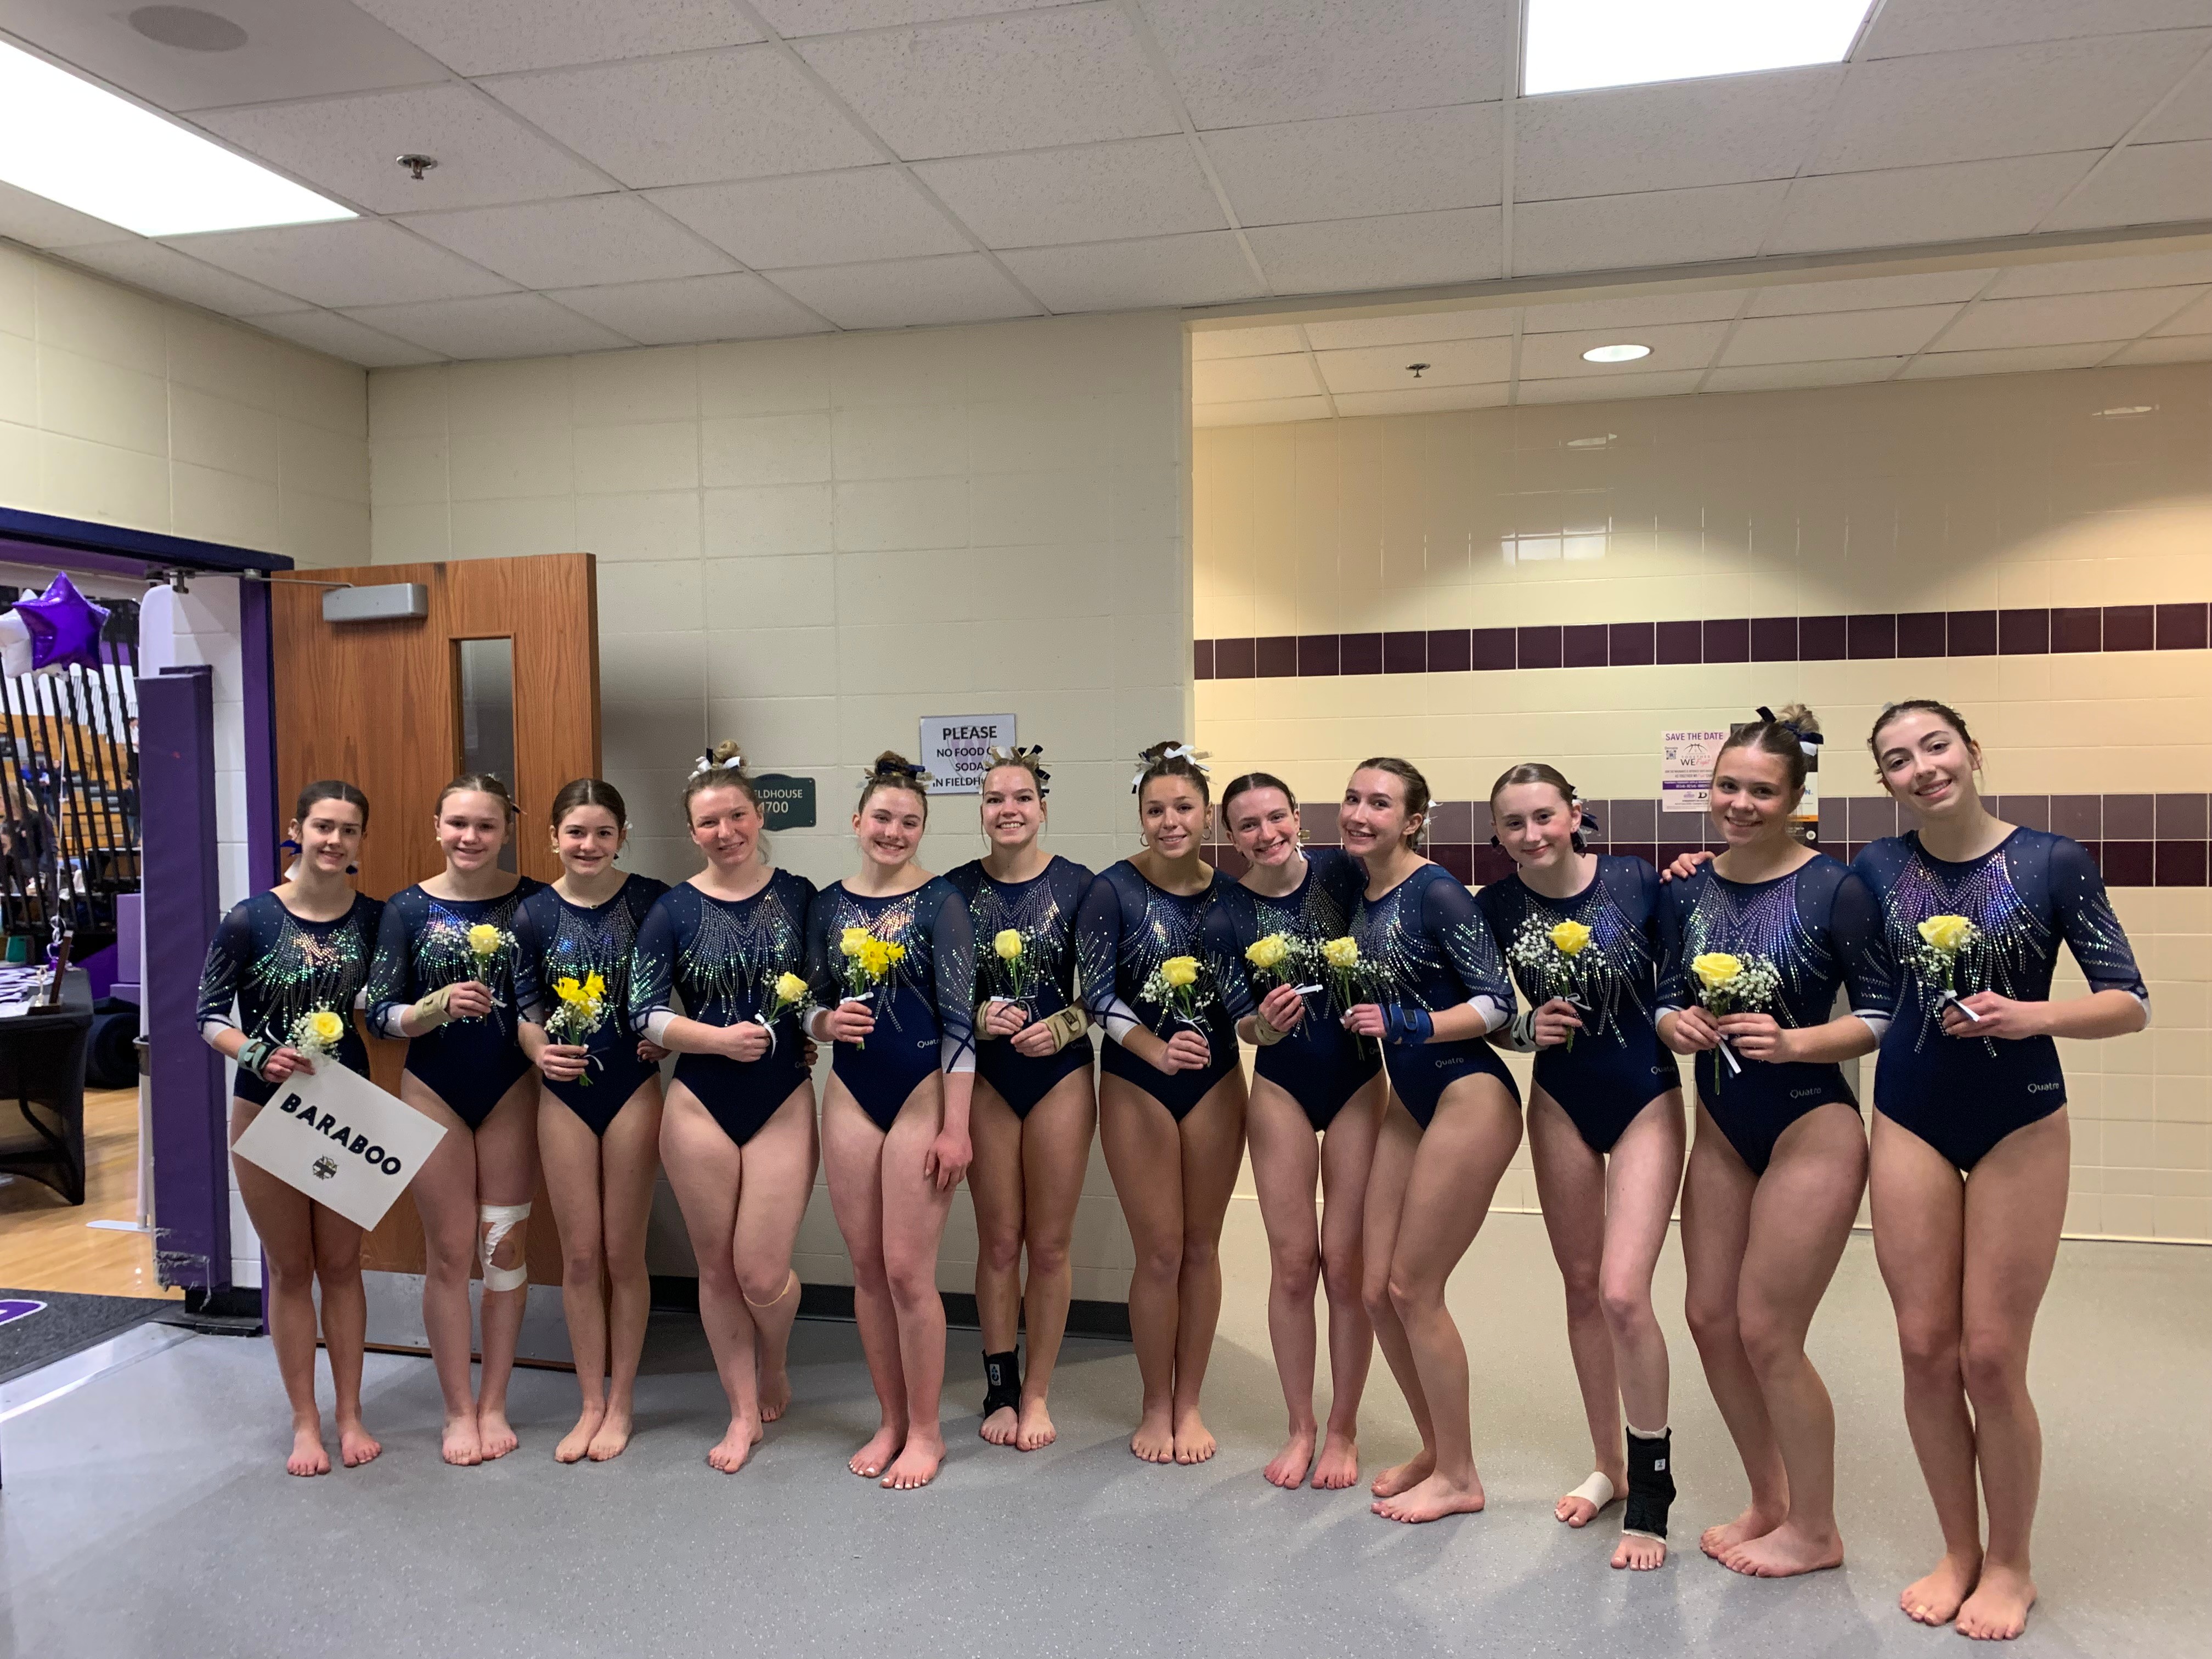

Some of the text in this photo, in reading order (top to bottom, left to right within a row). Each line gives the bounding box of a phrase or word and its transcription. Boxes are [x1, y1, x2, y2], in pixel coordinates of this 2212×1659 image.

[943, 725, 997, 741] PLEASE
[1704, 732, 1724, 740] DATE
[936, 748, 953, 758] NO
[955, 747, 985, 757] FOOD
[955, 761, 984, 771] SODA
[945, 777, 982, 787] FIELDH
[1435, 1058, 1464, 1068] Quatro
[1790, 1087, 1821, 1099] Quatro
[2028, 1082, 2059, 1094] Quatro
[280, 1092, 402, 1176] BARABOO
